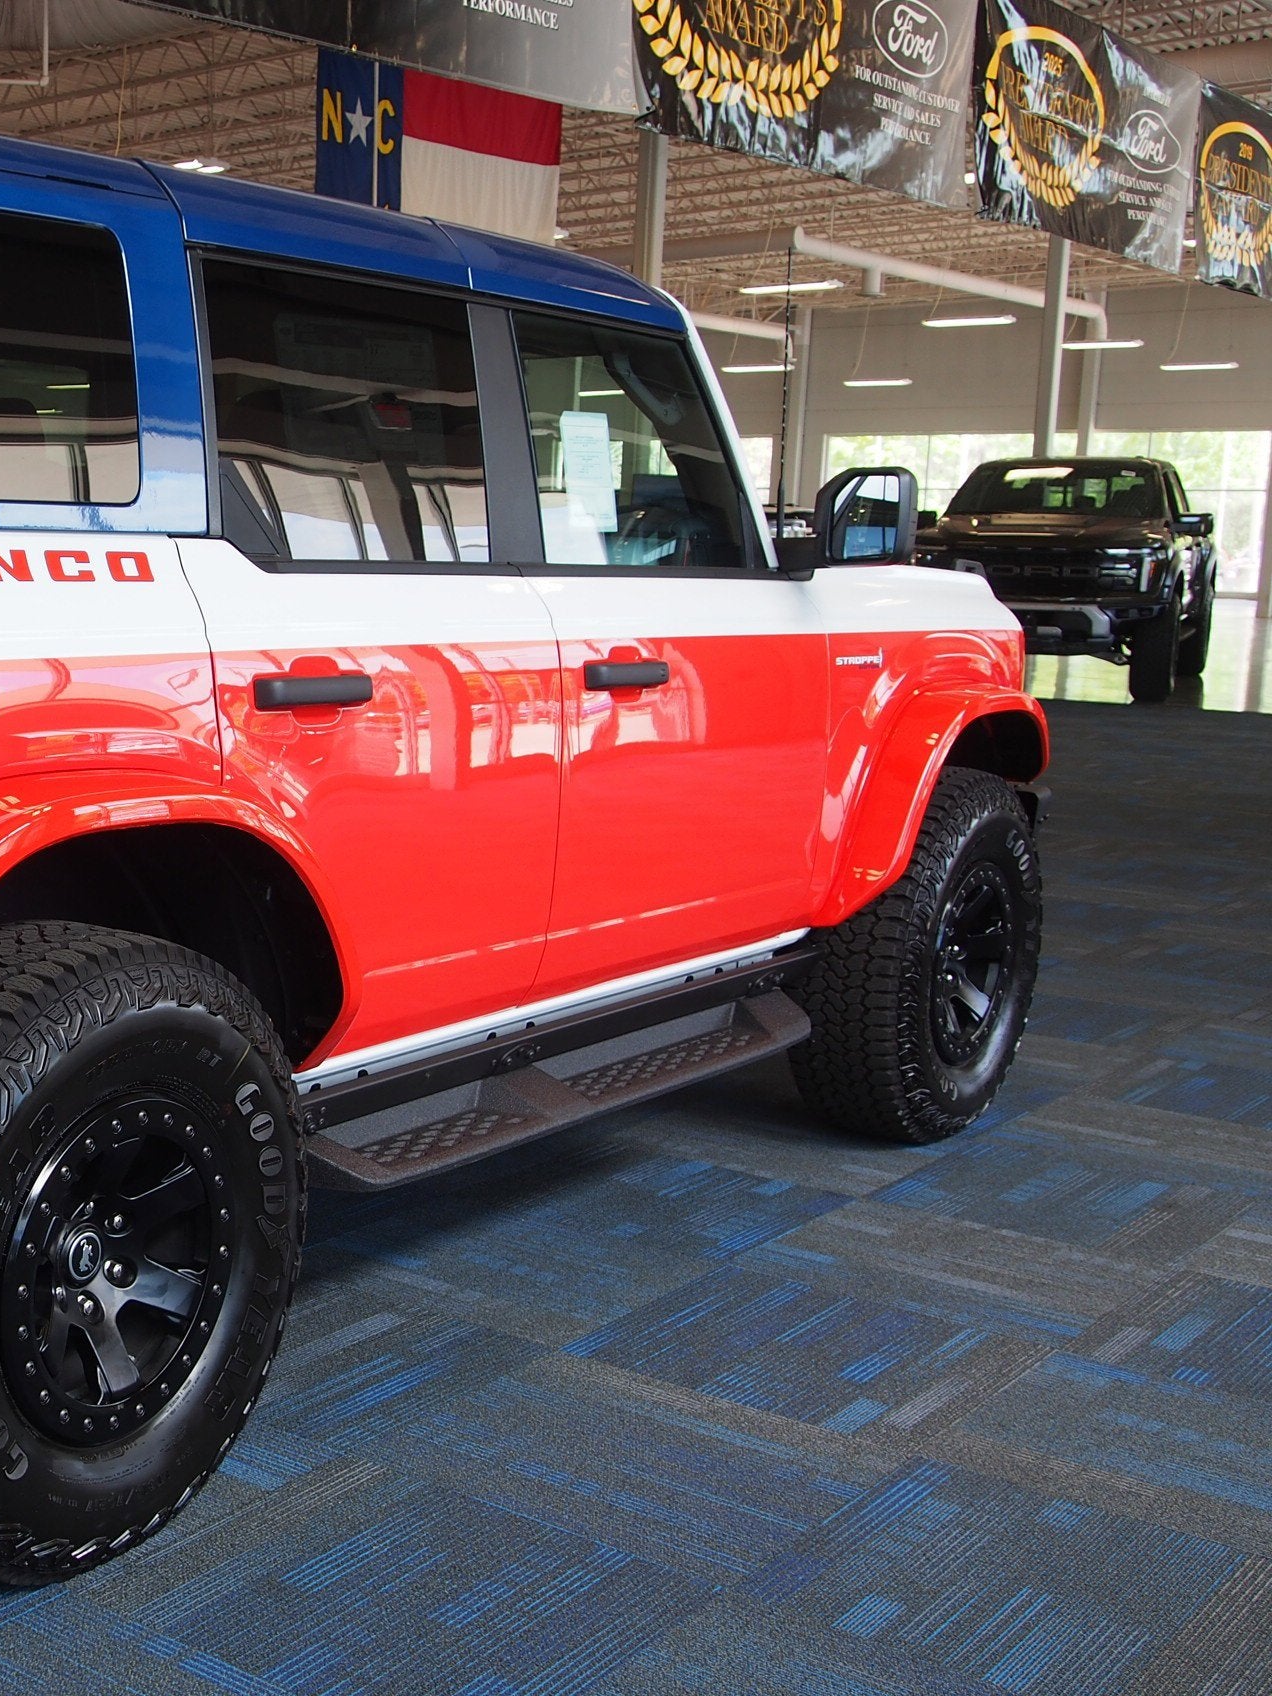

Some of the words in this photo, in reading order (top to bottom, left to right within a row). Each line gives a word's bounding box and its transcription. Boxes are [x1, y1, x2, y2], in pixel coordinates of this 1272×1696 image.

[701, 0, 789, 54] AWARD
[888, 5, 938, 65] Ford
[855, 65, 872, 83] FOR
[919, 89, 960, 114] CUSTOMER
[873, 93, 903, 115] SERVICE
[915, 109, 941, 127] SALES
[322, 88, 343, 143] N
[378, 99, 395, 155] C
[1131, 117, 1166, 163] Ford
[1118, 191, 1148, 206] SERVICE
[835, 655, 880, 666] STROPPE
